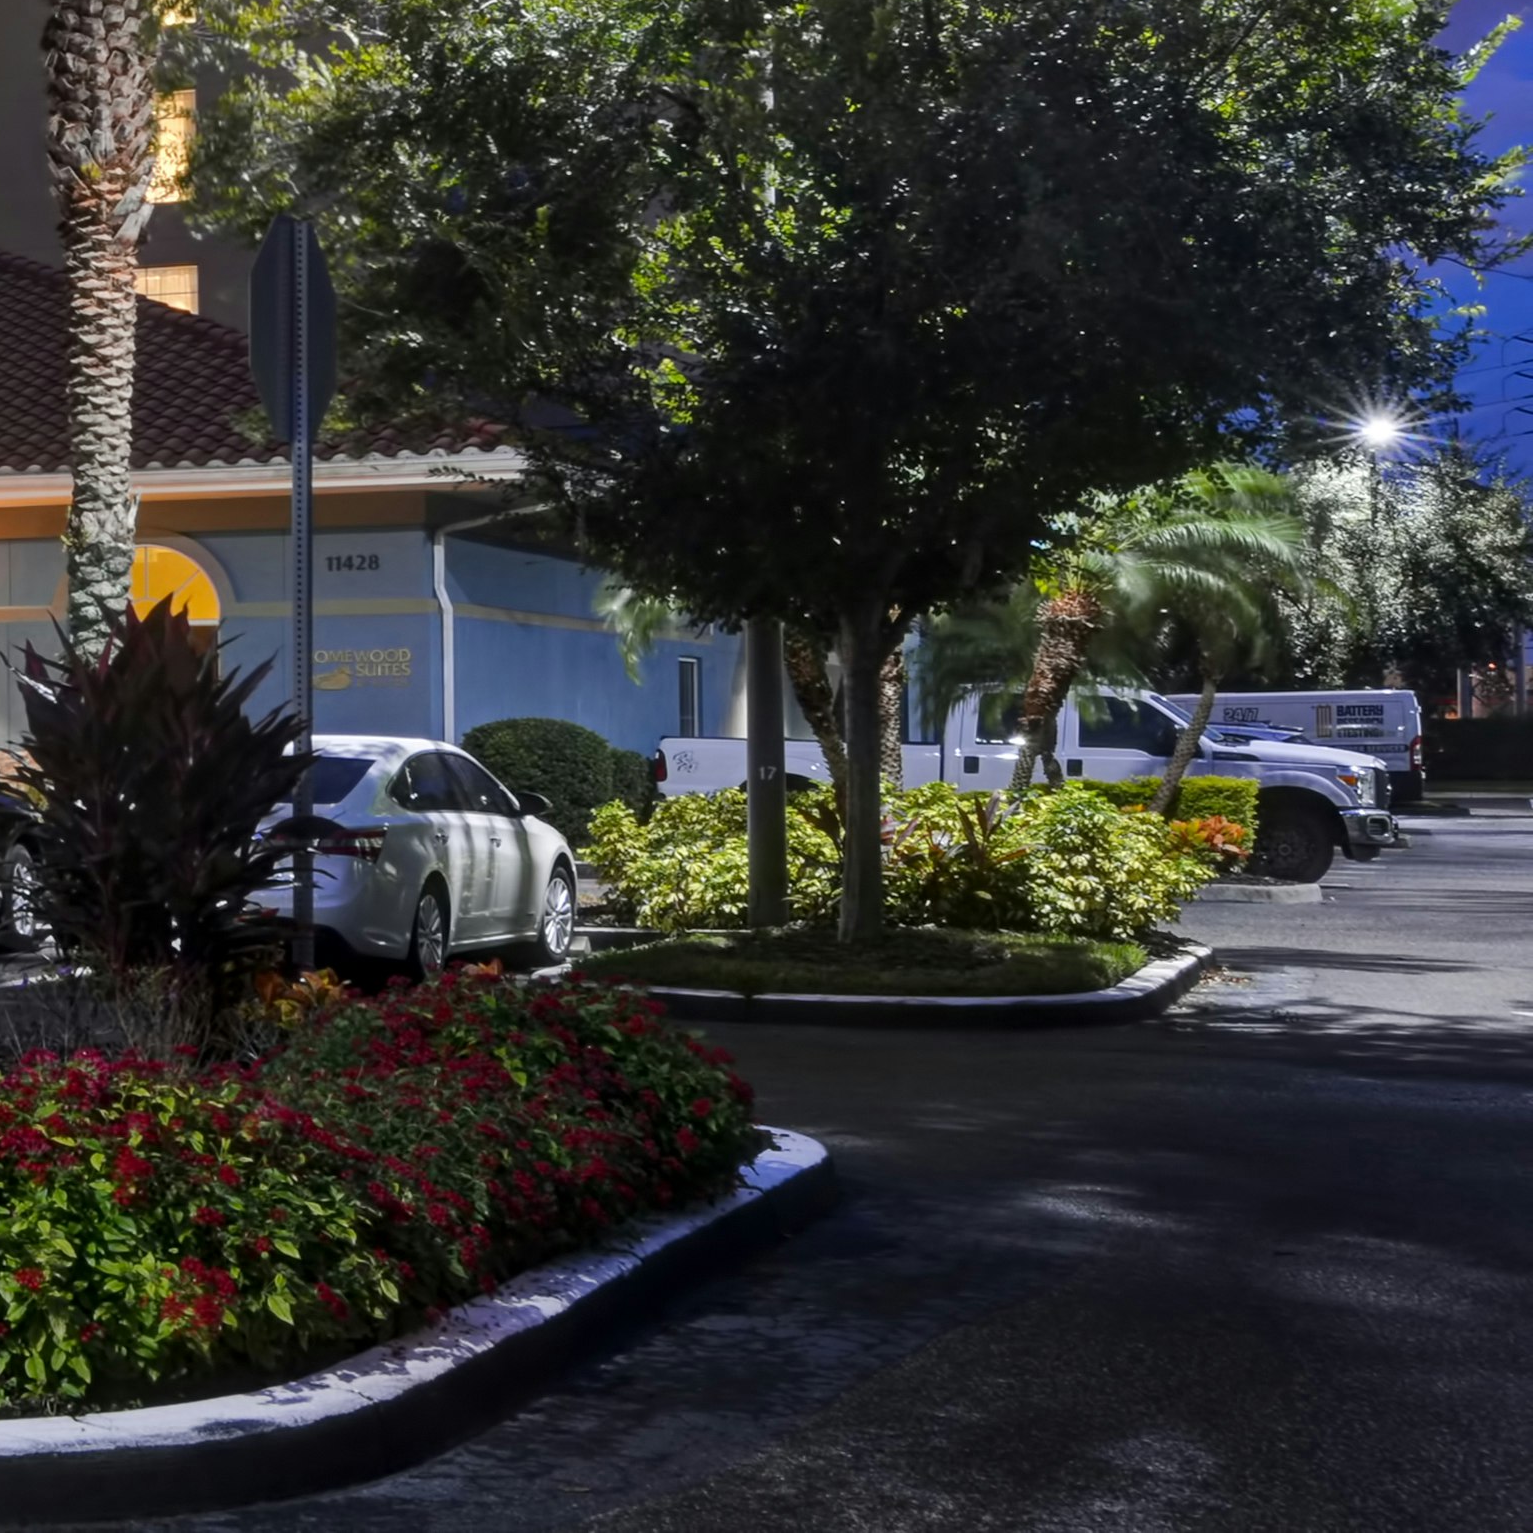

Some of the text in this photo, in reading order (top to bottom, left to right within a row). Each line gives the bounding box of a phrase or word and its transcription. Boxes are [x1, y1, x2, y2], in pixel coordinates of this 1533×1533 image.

[325, 554, 380, 572] 11428
[313, 648, 411, 664] OMEWOOD
[355, 663, 411, 676] SUITES
[1223, 707, 1259, 722] 24/7
[1336, 705, 1384, 717] BATTERY
[759, 766, 777, 780] 17
